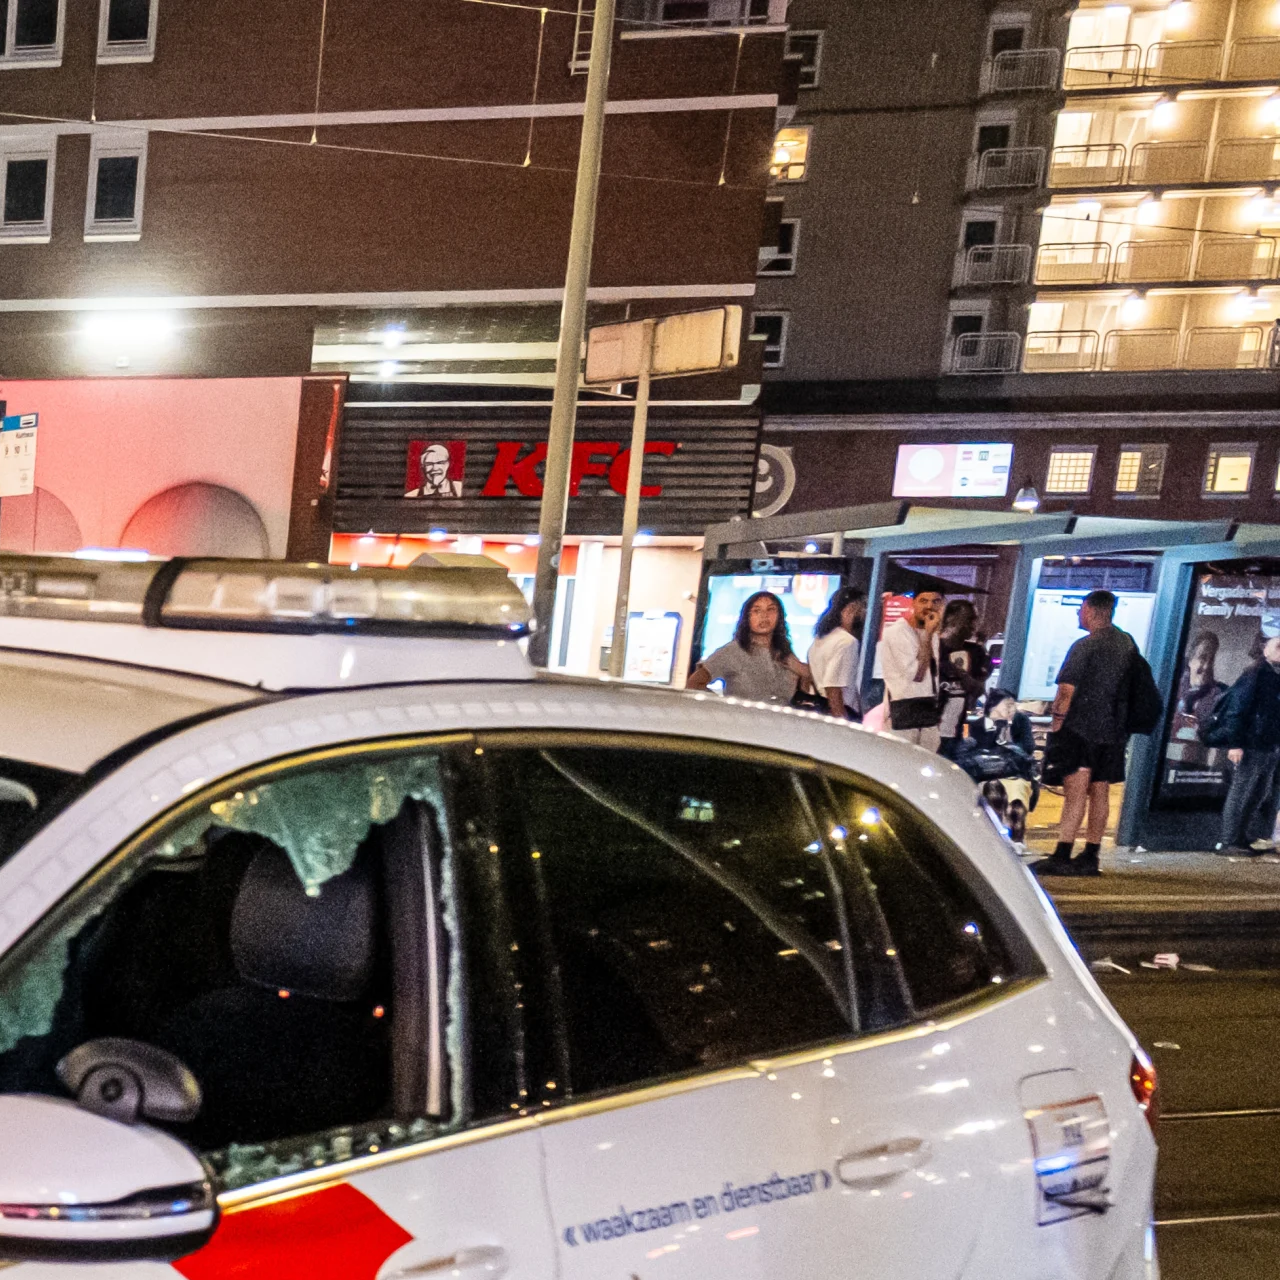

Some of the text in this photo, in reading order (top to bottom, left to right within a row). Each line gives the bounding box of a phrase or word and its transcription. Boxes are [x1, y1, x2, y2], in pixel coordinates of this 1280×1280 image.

[479, 441, 676, 498] KFC
[1198, 601, 1234, 619] Family
[581, 1204, 691, 1244] waakzaam
[693, 1194, 720, 1219] en
[720, 1171, 819, 1213] dienstbaar
